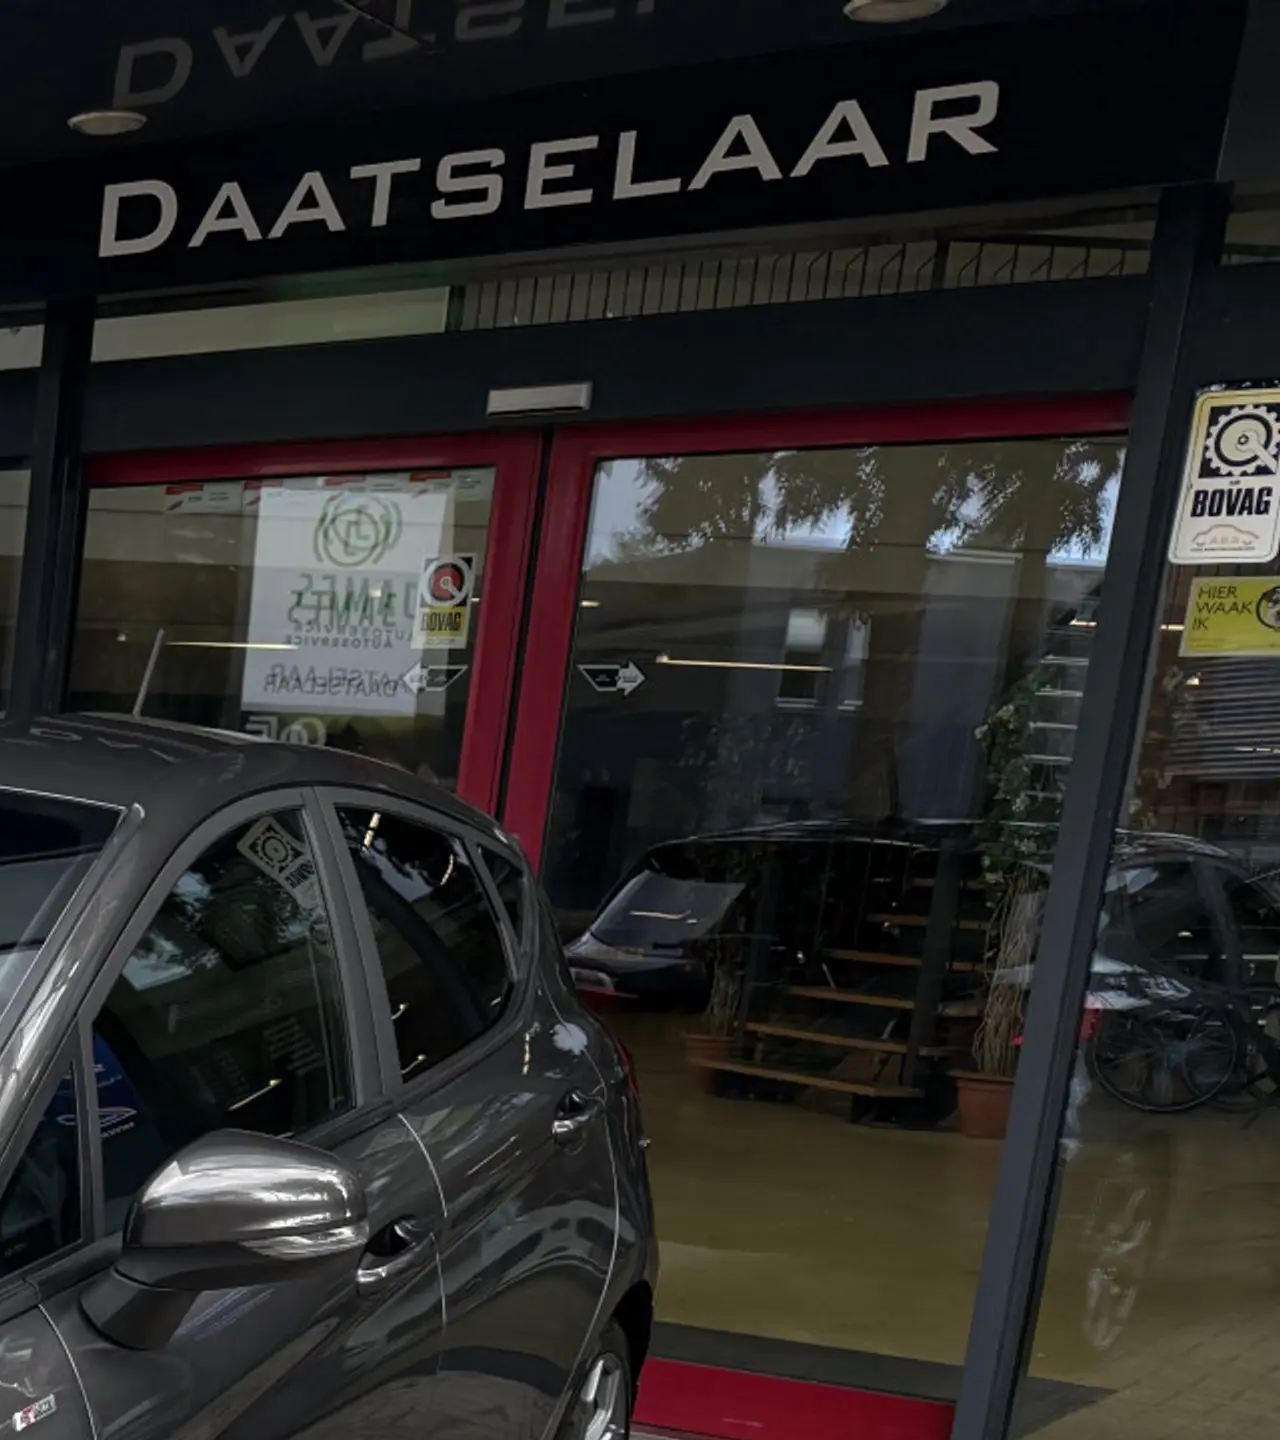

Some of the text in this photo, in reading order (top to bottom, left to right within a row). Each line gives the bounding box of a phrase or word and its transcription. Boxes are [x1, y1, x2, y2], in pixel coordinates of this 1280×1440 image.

[97, 79, 1001, 259] DAATSELAAR
[1191, 487, 1273, 517] BOVAG
[1198, 586, 1238, 600] HIER
[1195, 601, 1253, 616] WAAK
[420, 611, 462, 632] BOVAG
[1192, 617, 1210, 630] IK
